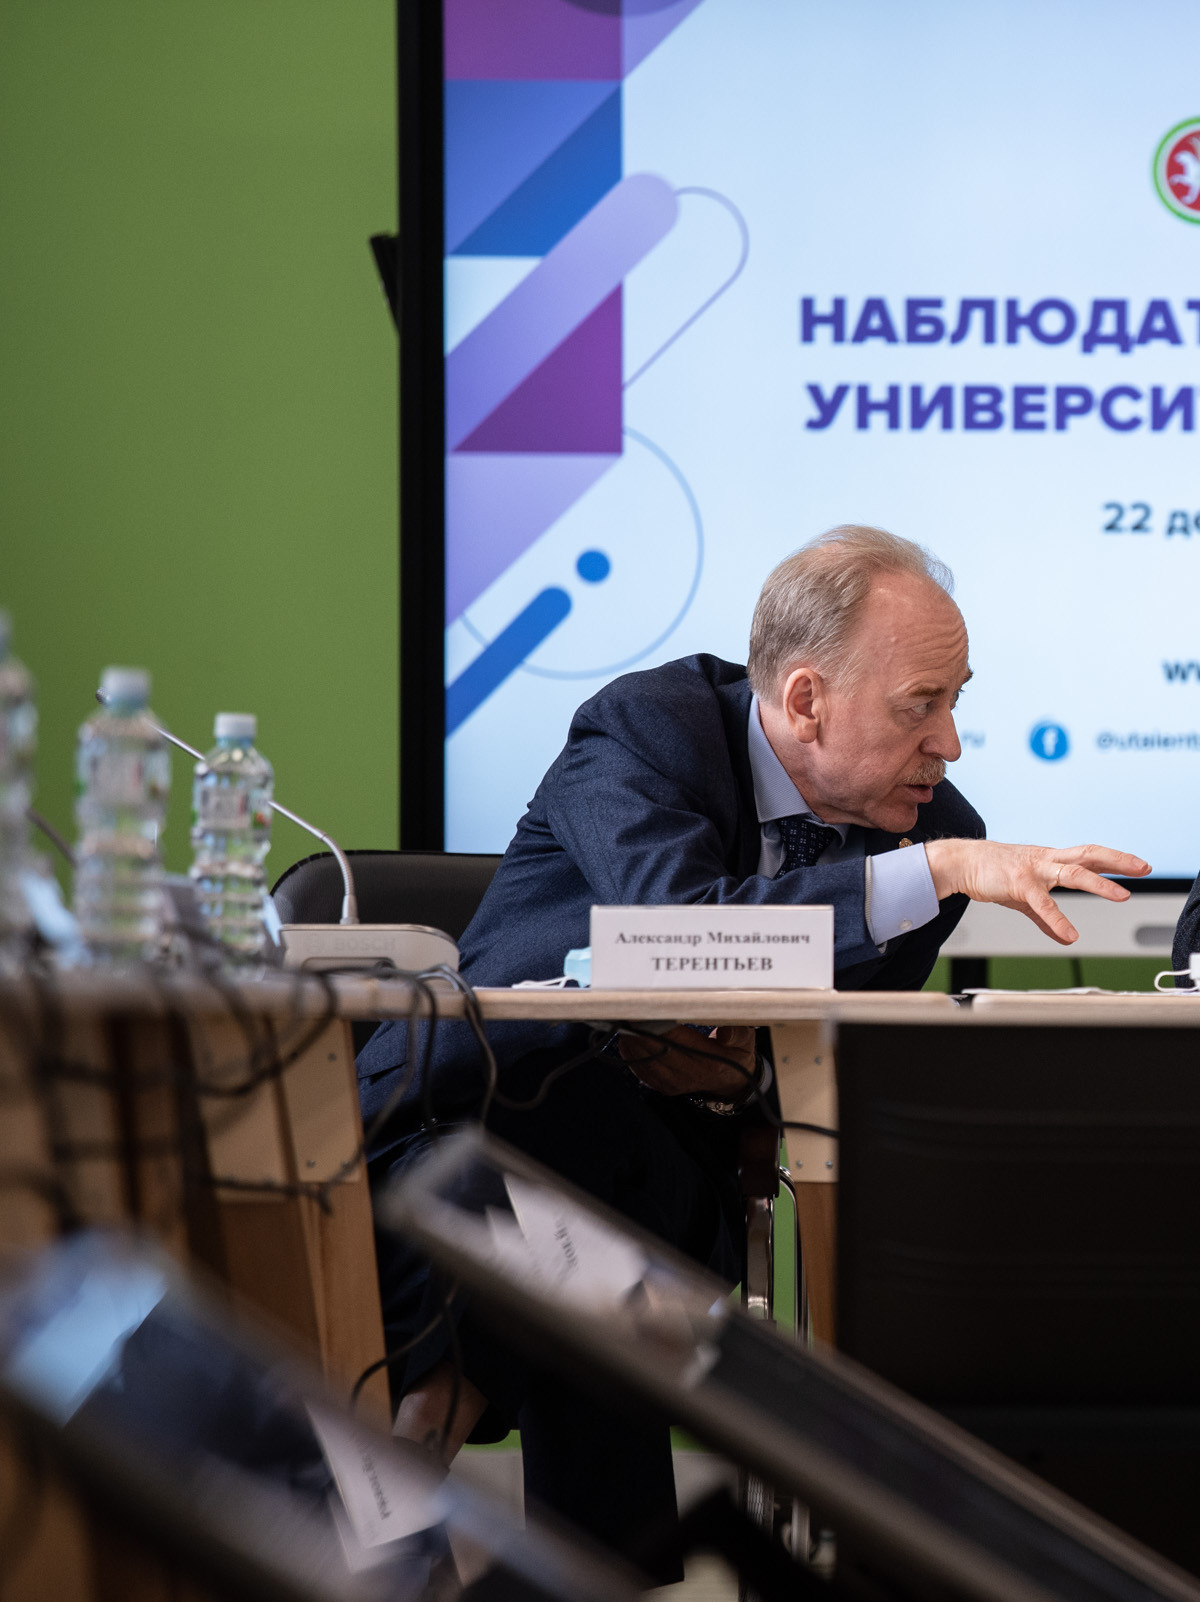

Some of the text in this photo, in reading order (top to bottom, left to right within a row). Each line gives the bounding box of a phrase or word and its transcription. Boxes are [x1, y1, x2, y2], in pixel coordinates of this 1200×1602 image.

[1103, 501, 1152, 534] 22
[614, 931, 811, 947] Александр Михайлович
[651, 956, 774, 972] ТЕРЕНТЬЕВ
